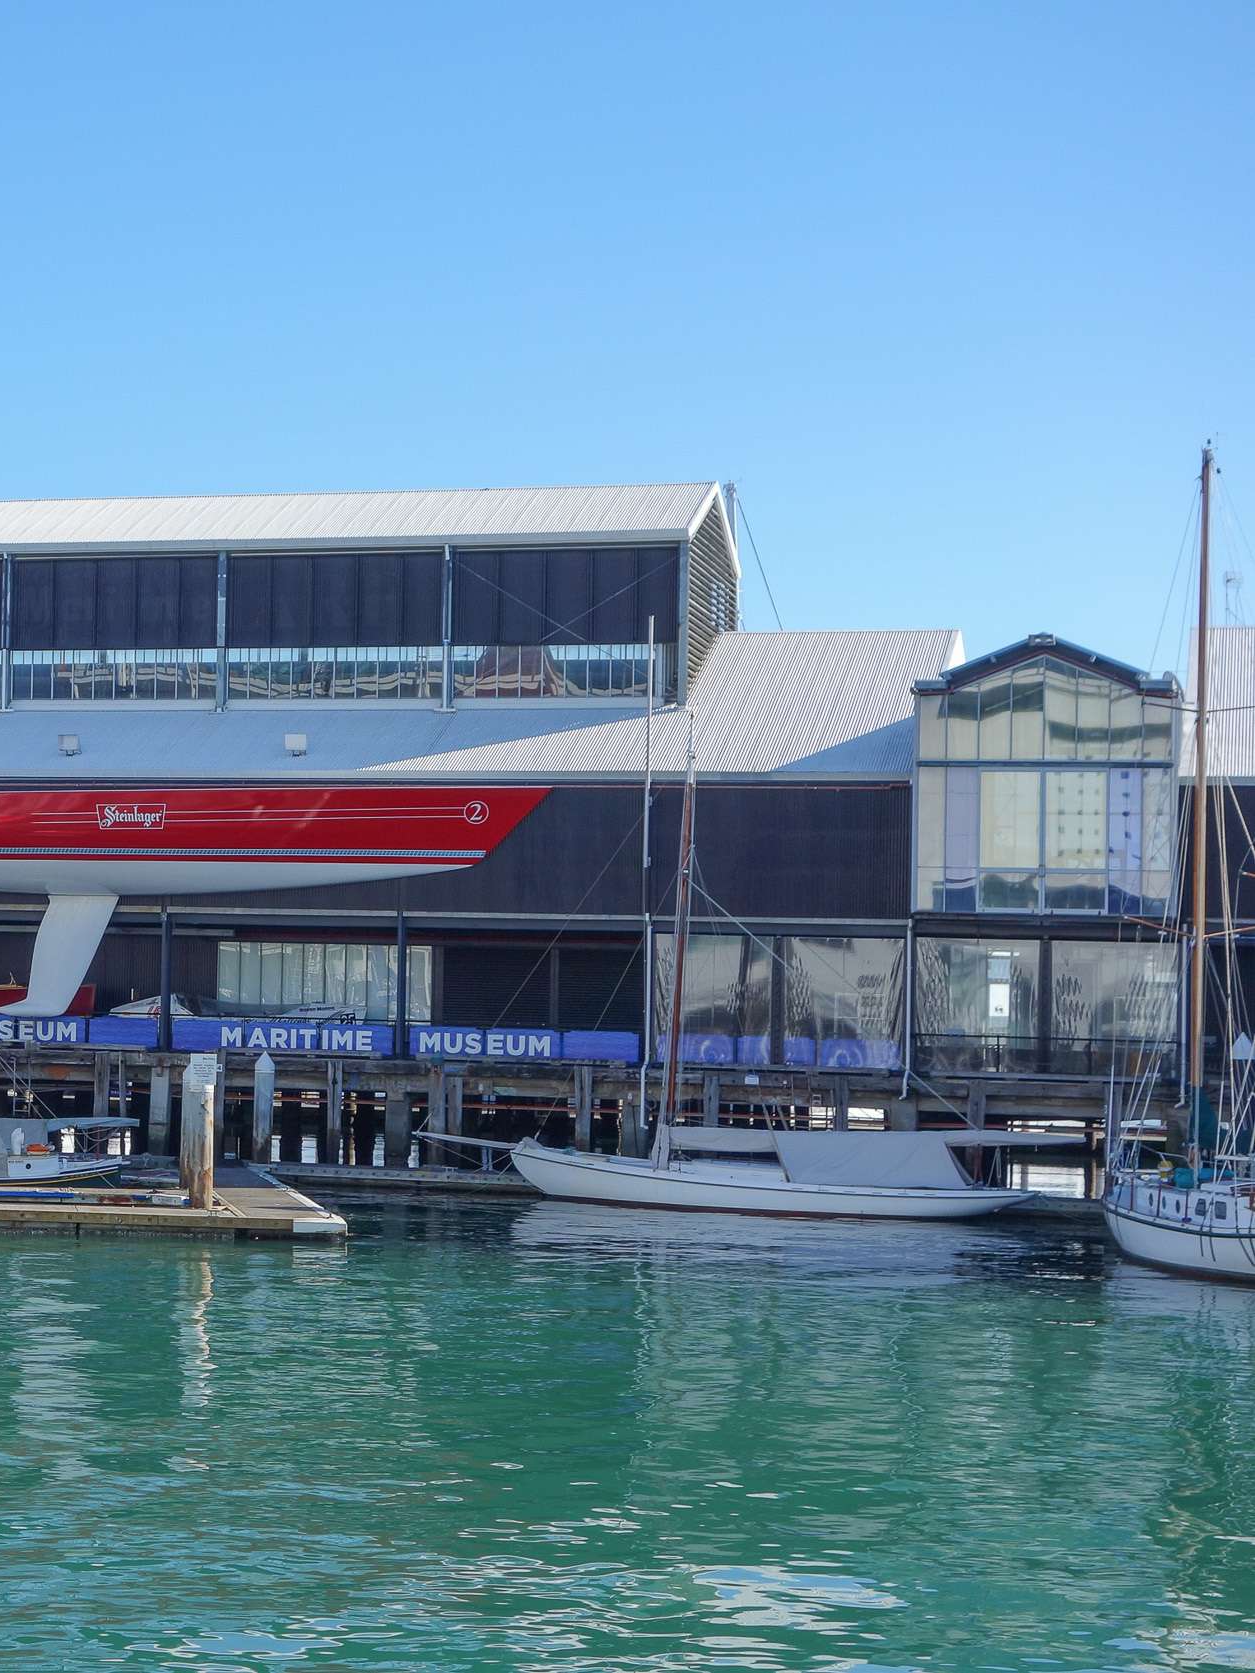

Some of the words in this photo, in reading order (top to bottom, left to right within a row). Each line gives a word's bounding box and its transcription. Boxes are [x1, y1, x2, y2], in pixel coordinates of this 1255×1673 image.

[100, 805, 162, 827] Steinlager
[469, 803, 483, 821] 2
[221, 1026, 373, 1051] MARITIME
[419, 1031, 551, 1057] MUSEUM
